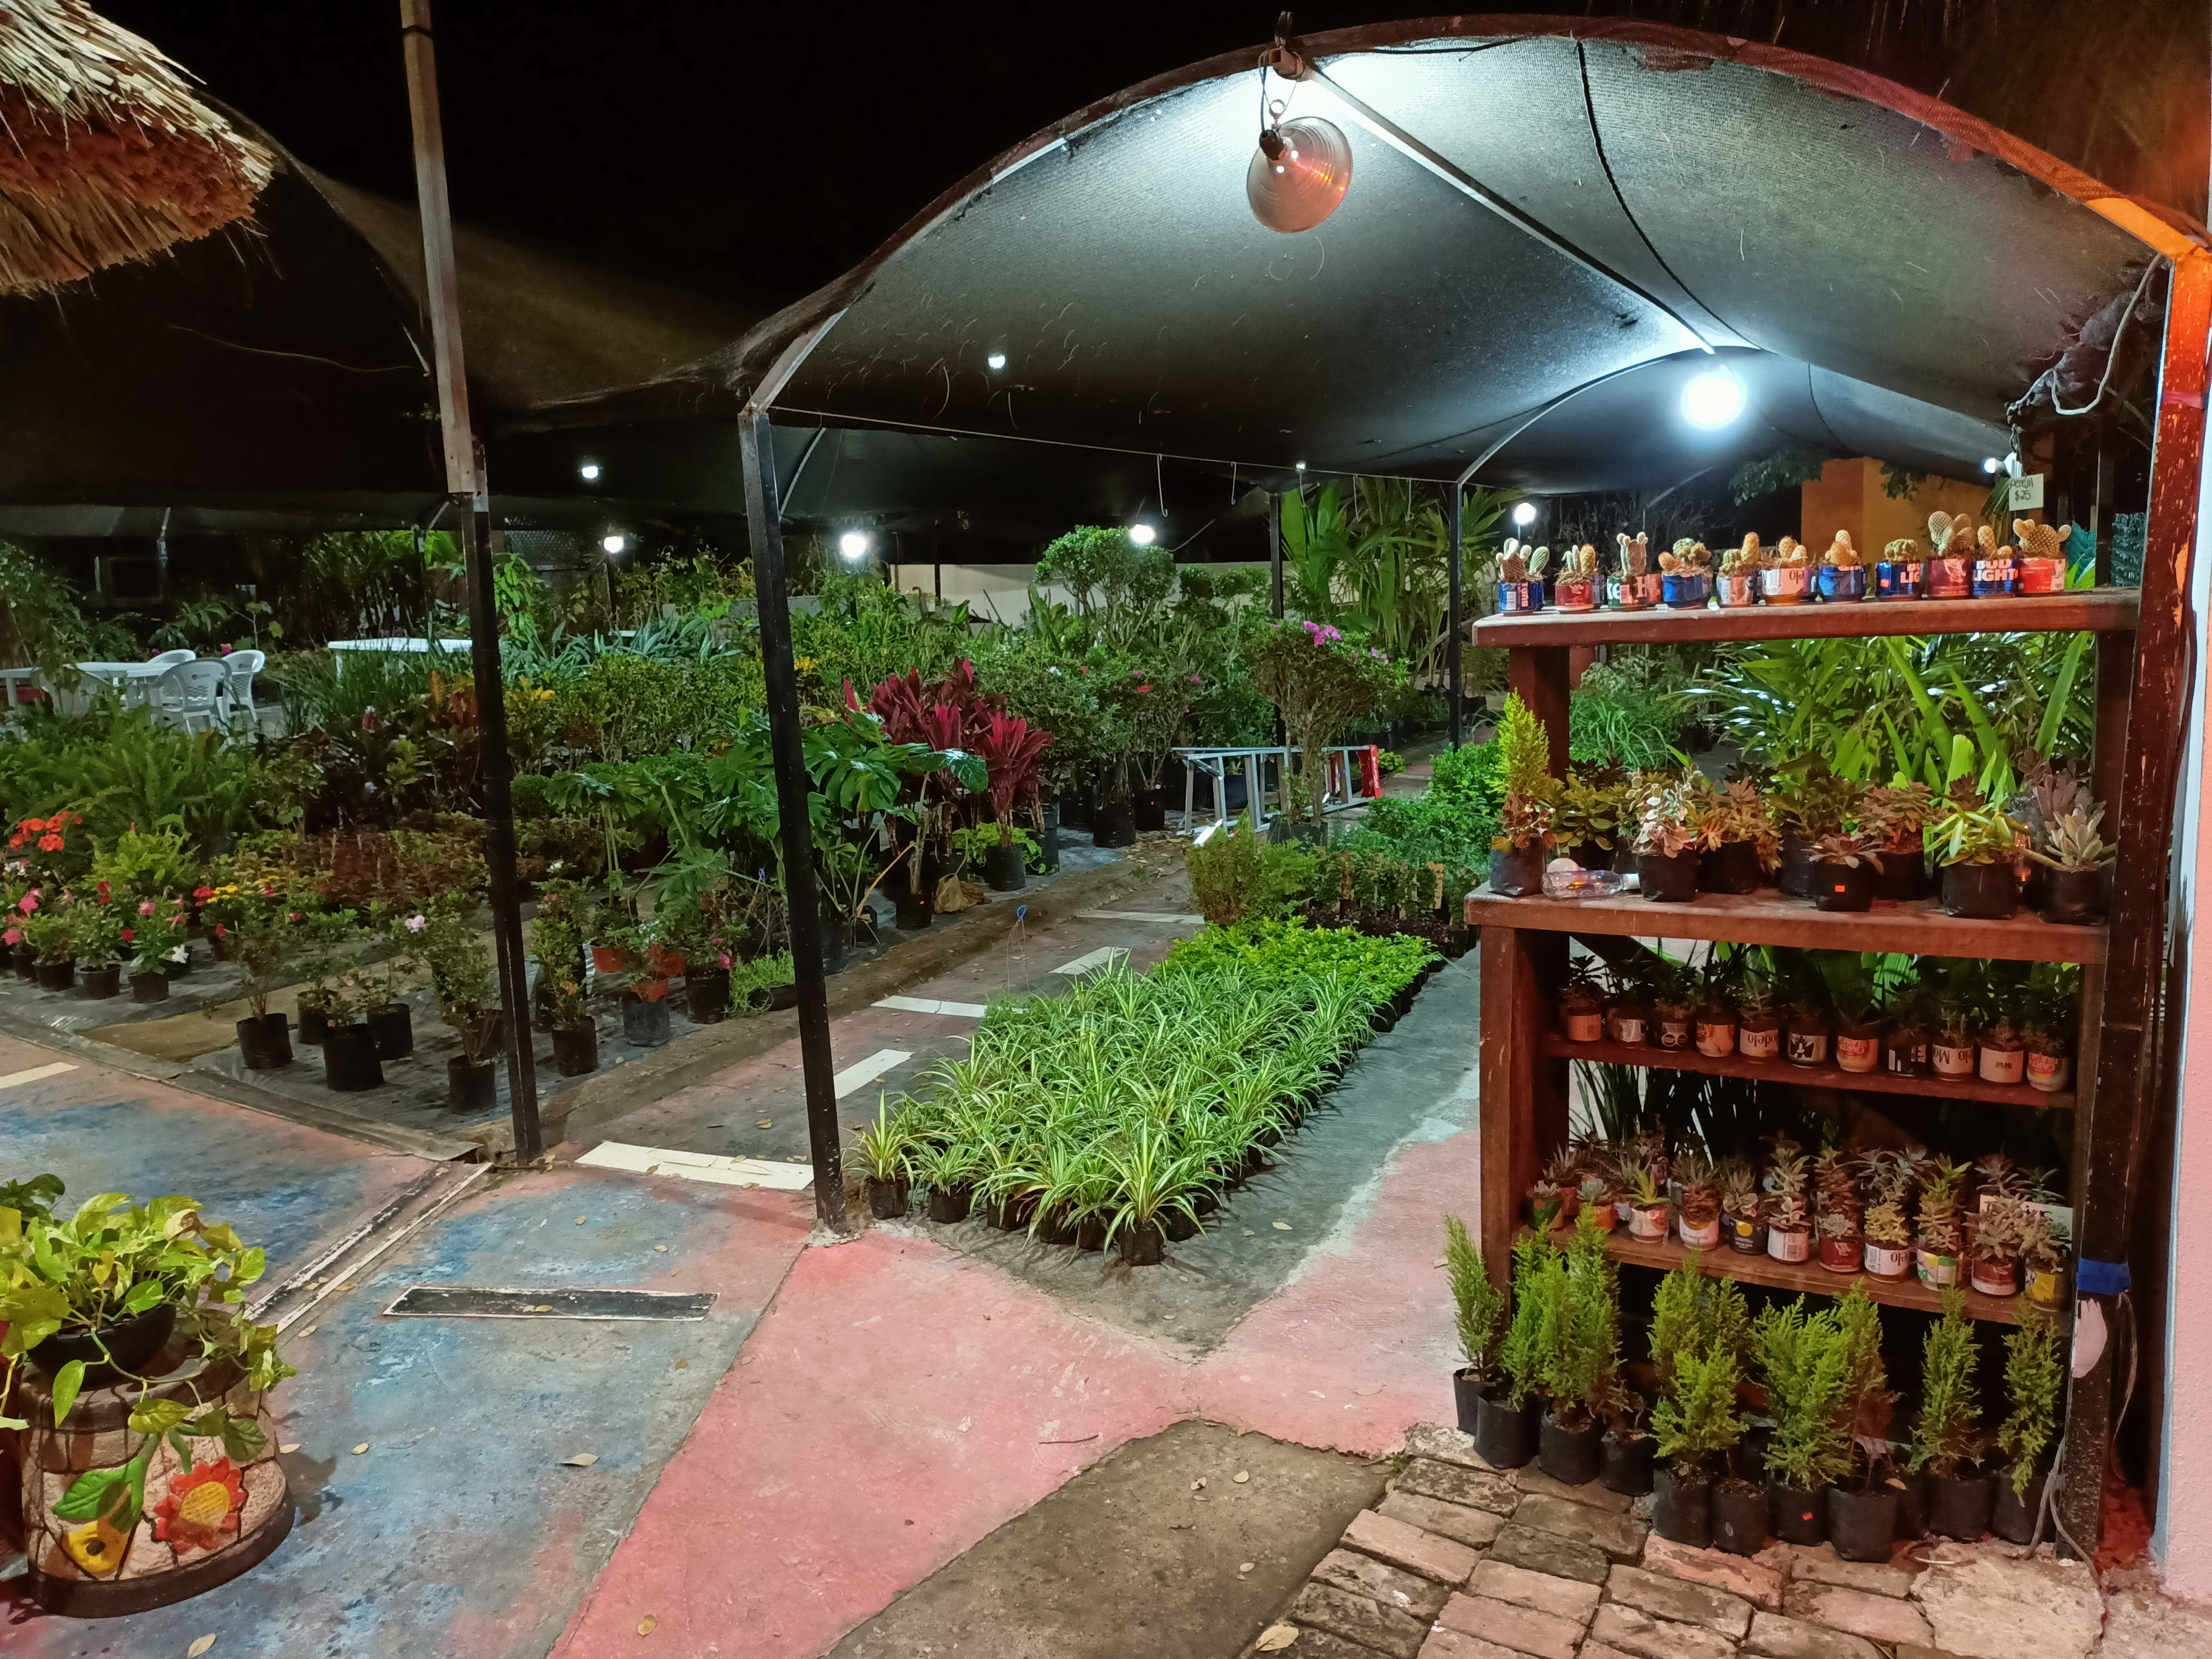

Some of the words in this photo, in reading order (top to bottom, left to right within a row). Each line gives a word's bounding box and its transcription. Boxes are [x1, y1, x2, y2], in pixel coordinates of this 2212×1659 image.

[2015, 490, 2031, 503] $25
[1976, 559, 2012, 569] BUD
[1747, 1034, 1777, 1048] odelo
[1891, 1251, 1908, 1266] elo
